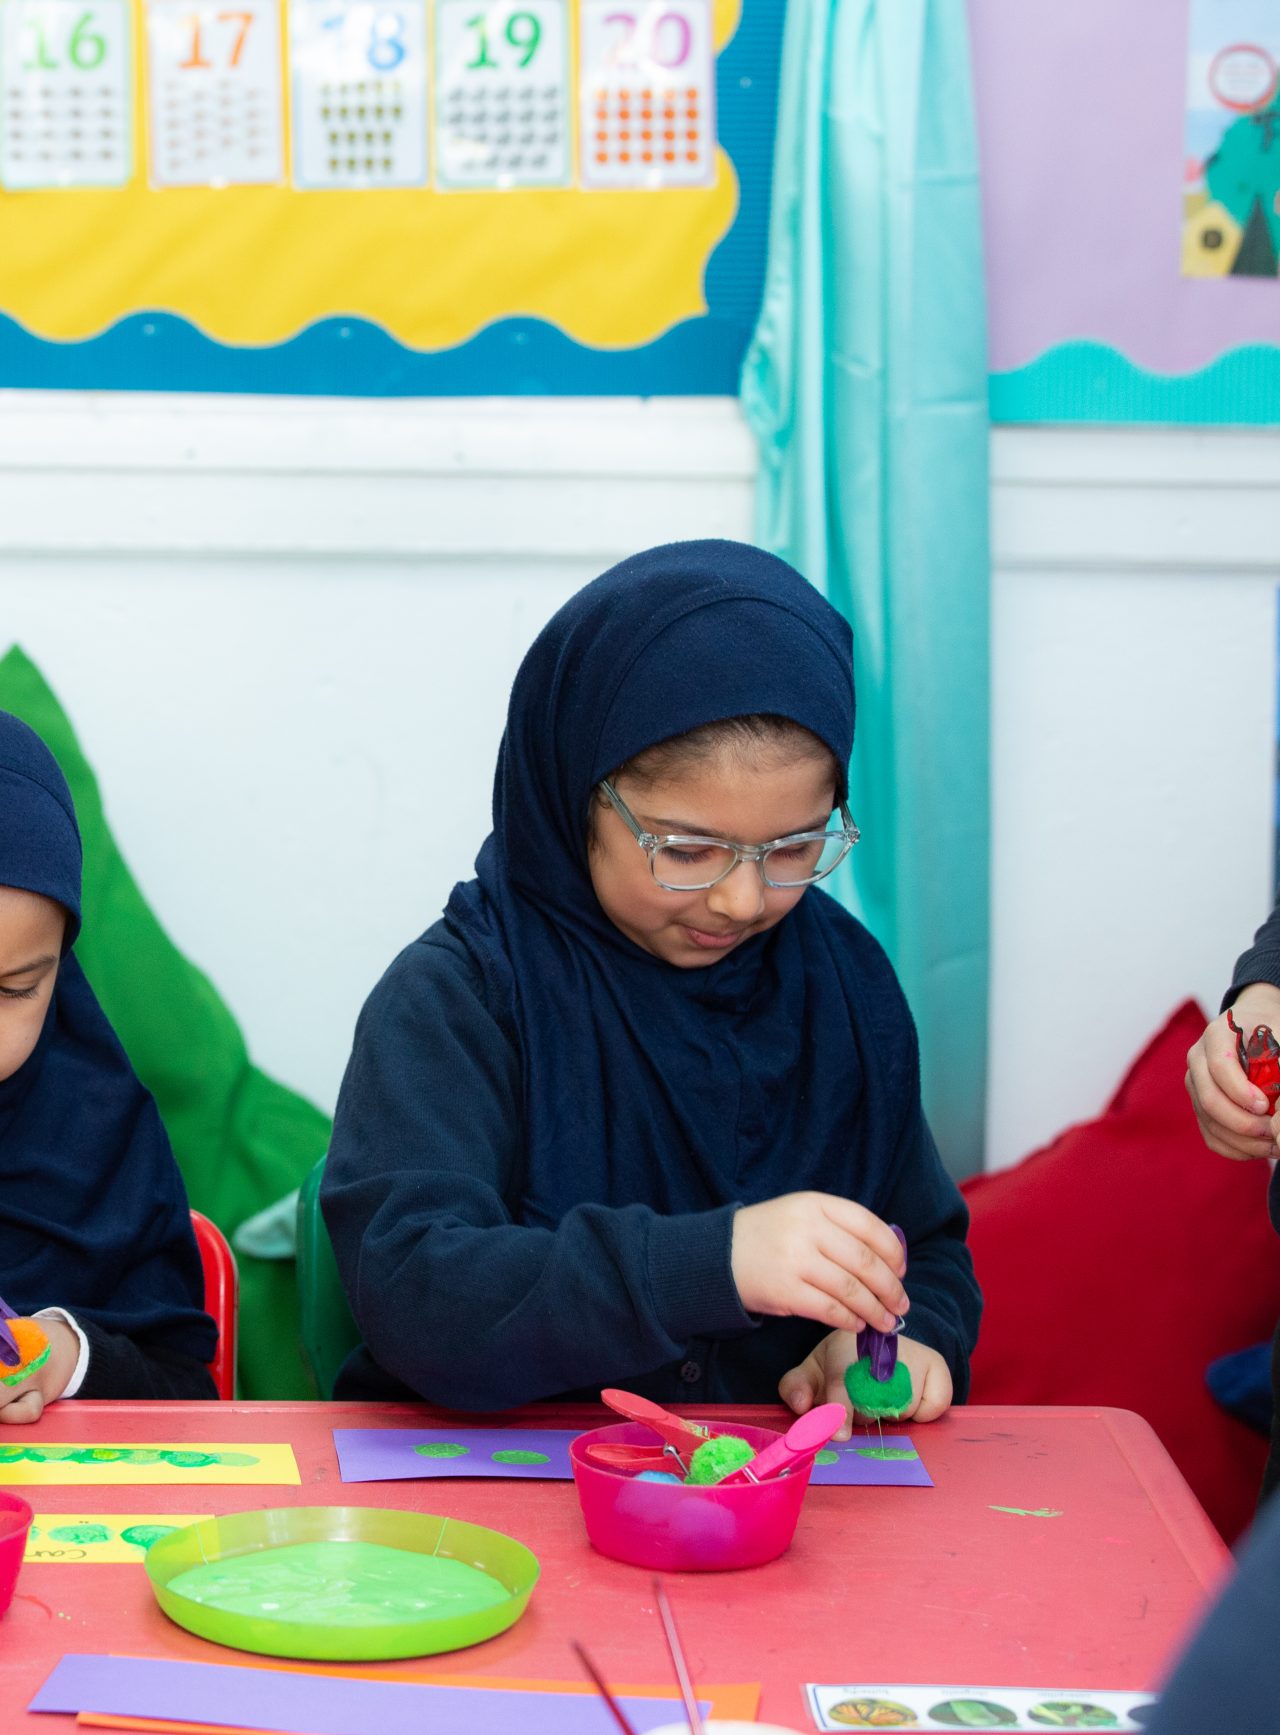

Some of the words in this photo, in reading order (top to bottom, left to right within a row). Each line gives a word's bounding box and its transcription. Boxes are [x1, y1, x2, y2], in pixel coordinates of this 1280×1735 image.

[21, 11, 107, 71] 16
[177, 11, 256, 69] 17
[465, 11, 543, 69] 19
[602, 12, 694, 70] 20
